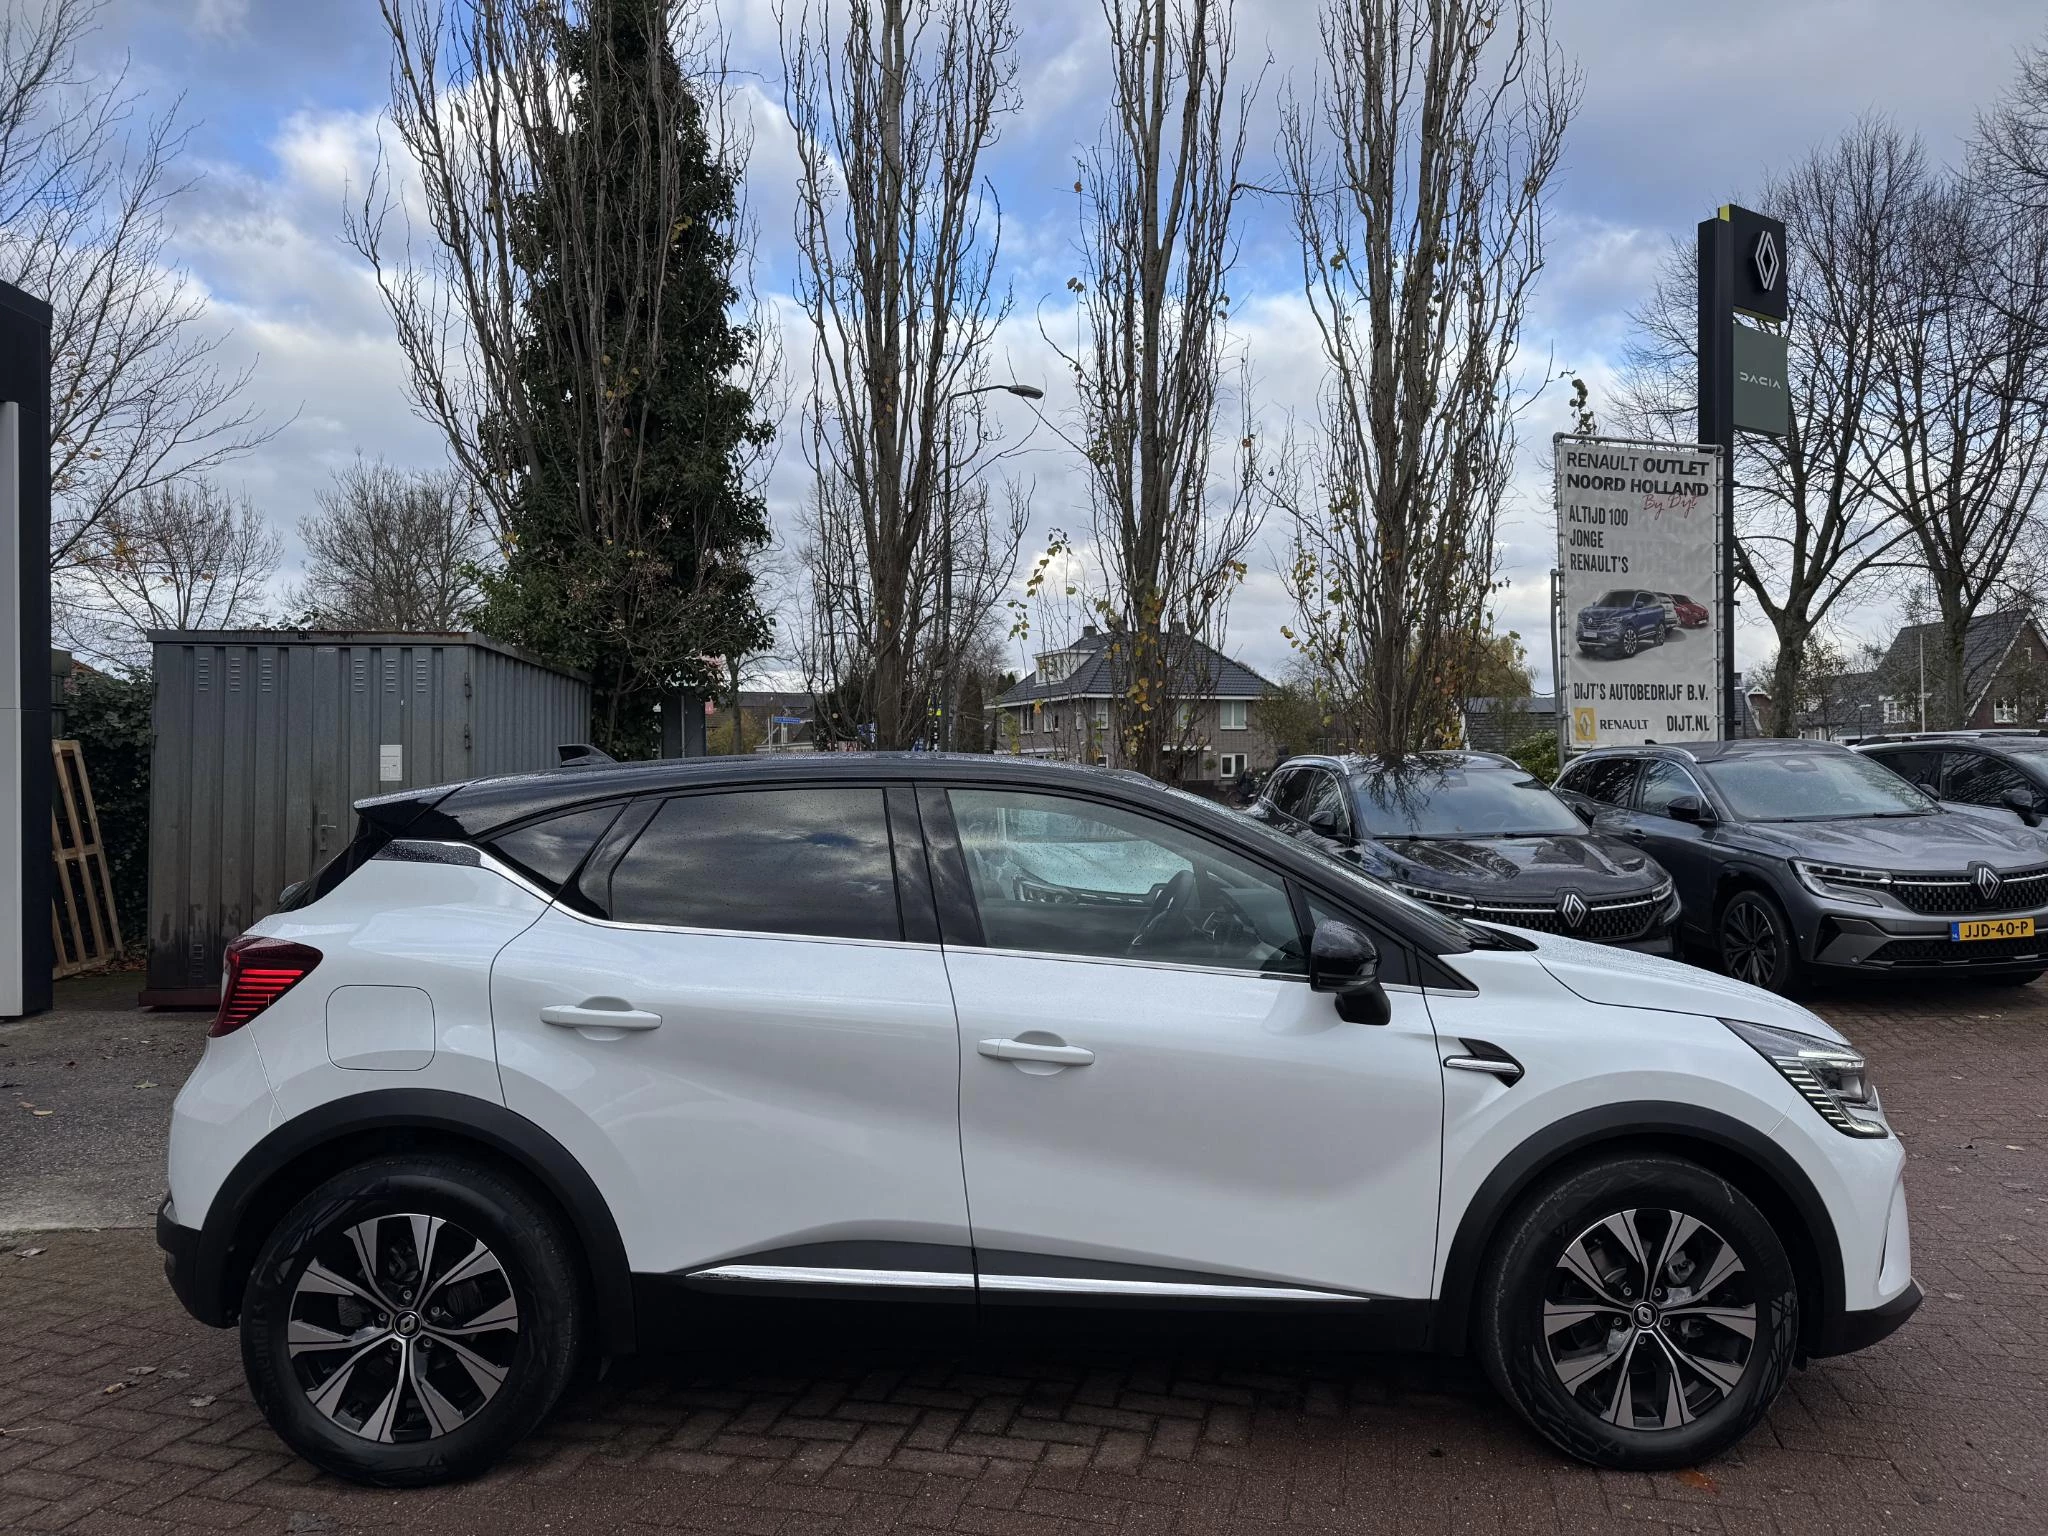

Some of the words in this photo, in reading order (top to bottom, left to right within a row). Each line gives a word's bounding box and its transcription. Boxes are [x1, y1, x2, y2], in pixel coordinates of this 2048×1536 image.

[1739, 371, 1781, 389] DACIA
[1566, 452, 1639, 471] RENAULT
[1642, 457, 1709, 476] OUTLET
[1567, 474, 1625, 491] NOORD
[1630, 478, 1709, 496] HOLLAND
[1569, 505, 1605, 525] ALTIJD
[1608, 508, 1628, 526] 100
[1642, 494, 1665, 520] By
[1569, 529, 1604, 548] JONGE
[1570, 552, 1628, 573] RENAULT'S
[1574, 682, 1606, 700] DIJT'S
[1609, 683, 1683, 701] AUTOBEDRIJF
[1687, 684, 1709, 700] B.V.
[1600, 719, 1649, 730] RENAULT
[1666, 715, 1710, 732] DIJT.NL
[1965, 921, 2028, 938] JJD-40-P
